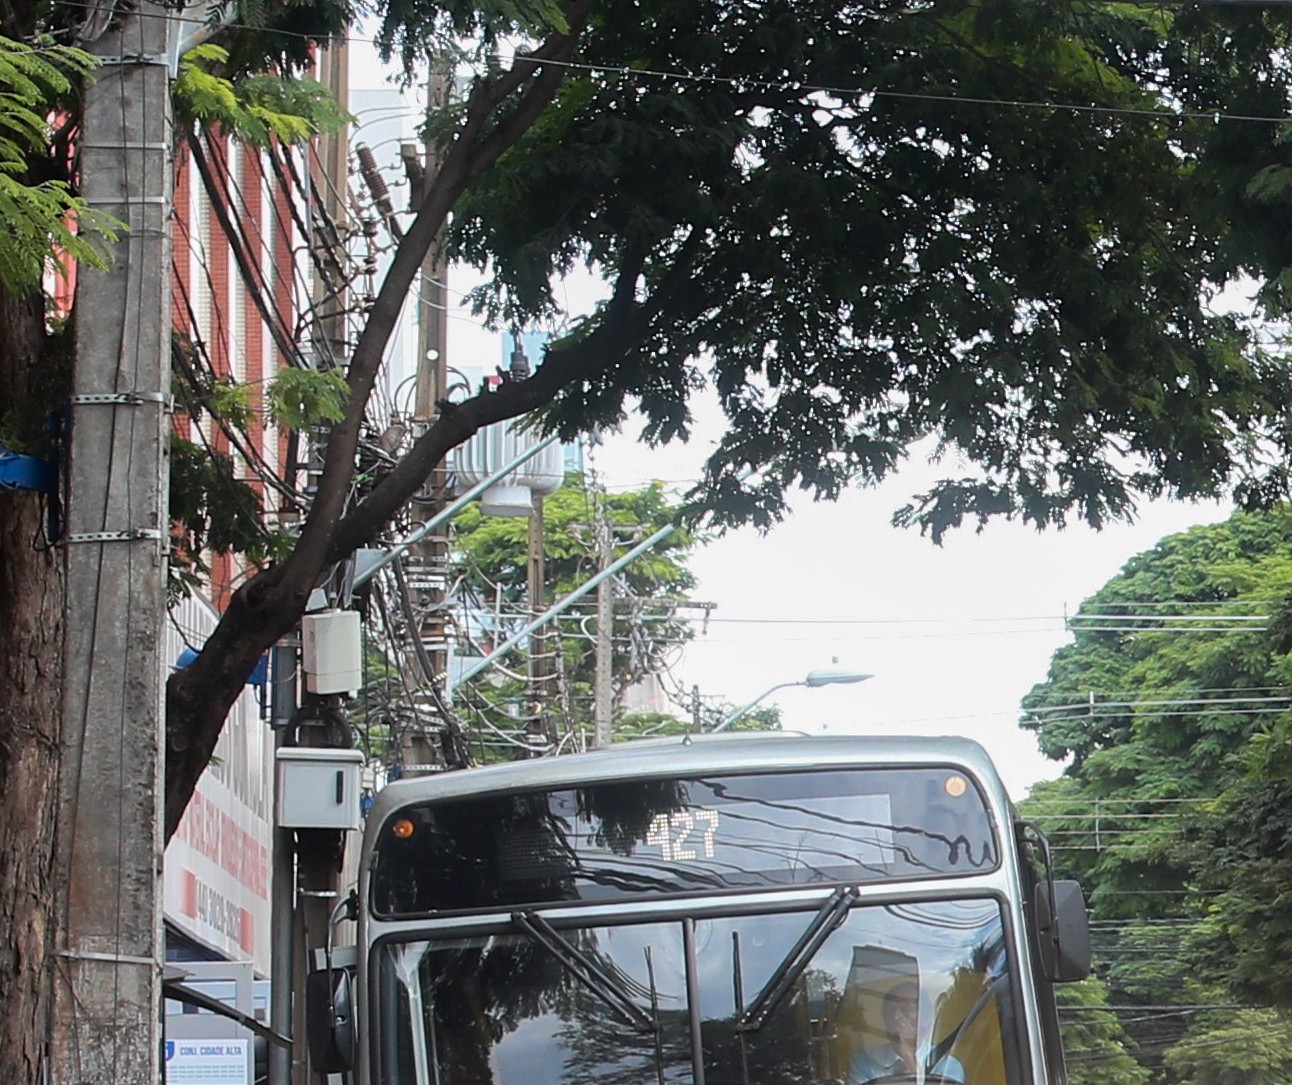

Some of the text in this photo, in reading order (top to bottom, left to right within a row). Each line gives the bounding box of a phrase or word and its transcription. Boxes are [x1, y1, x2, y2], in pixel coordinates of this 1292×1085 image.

[646, 810, 720, 861] 427
[200, 1046, 223, 1056] CIDADE
[225, 1046, 242, 1056] ALTA
